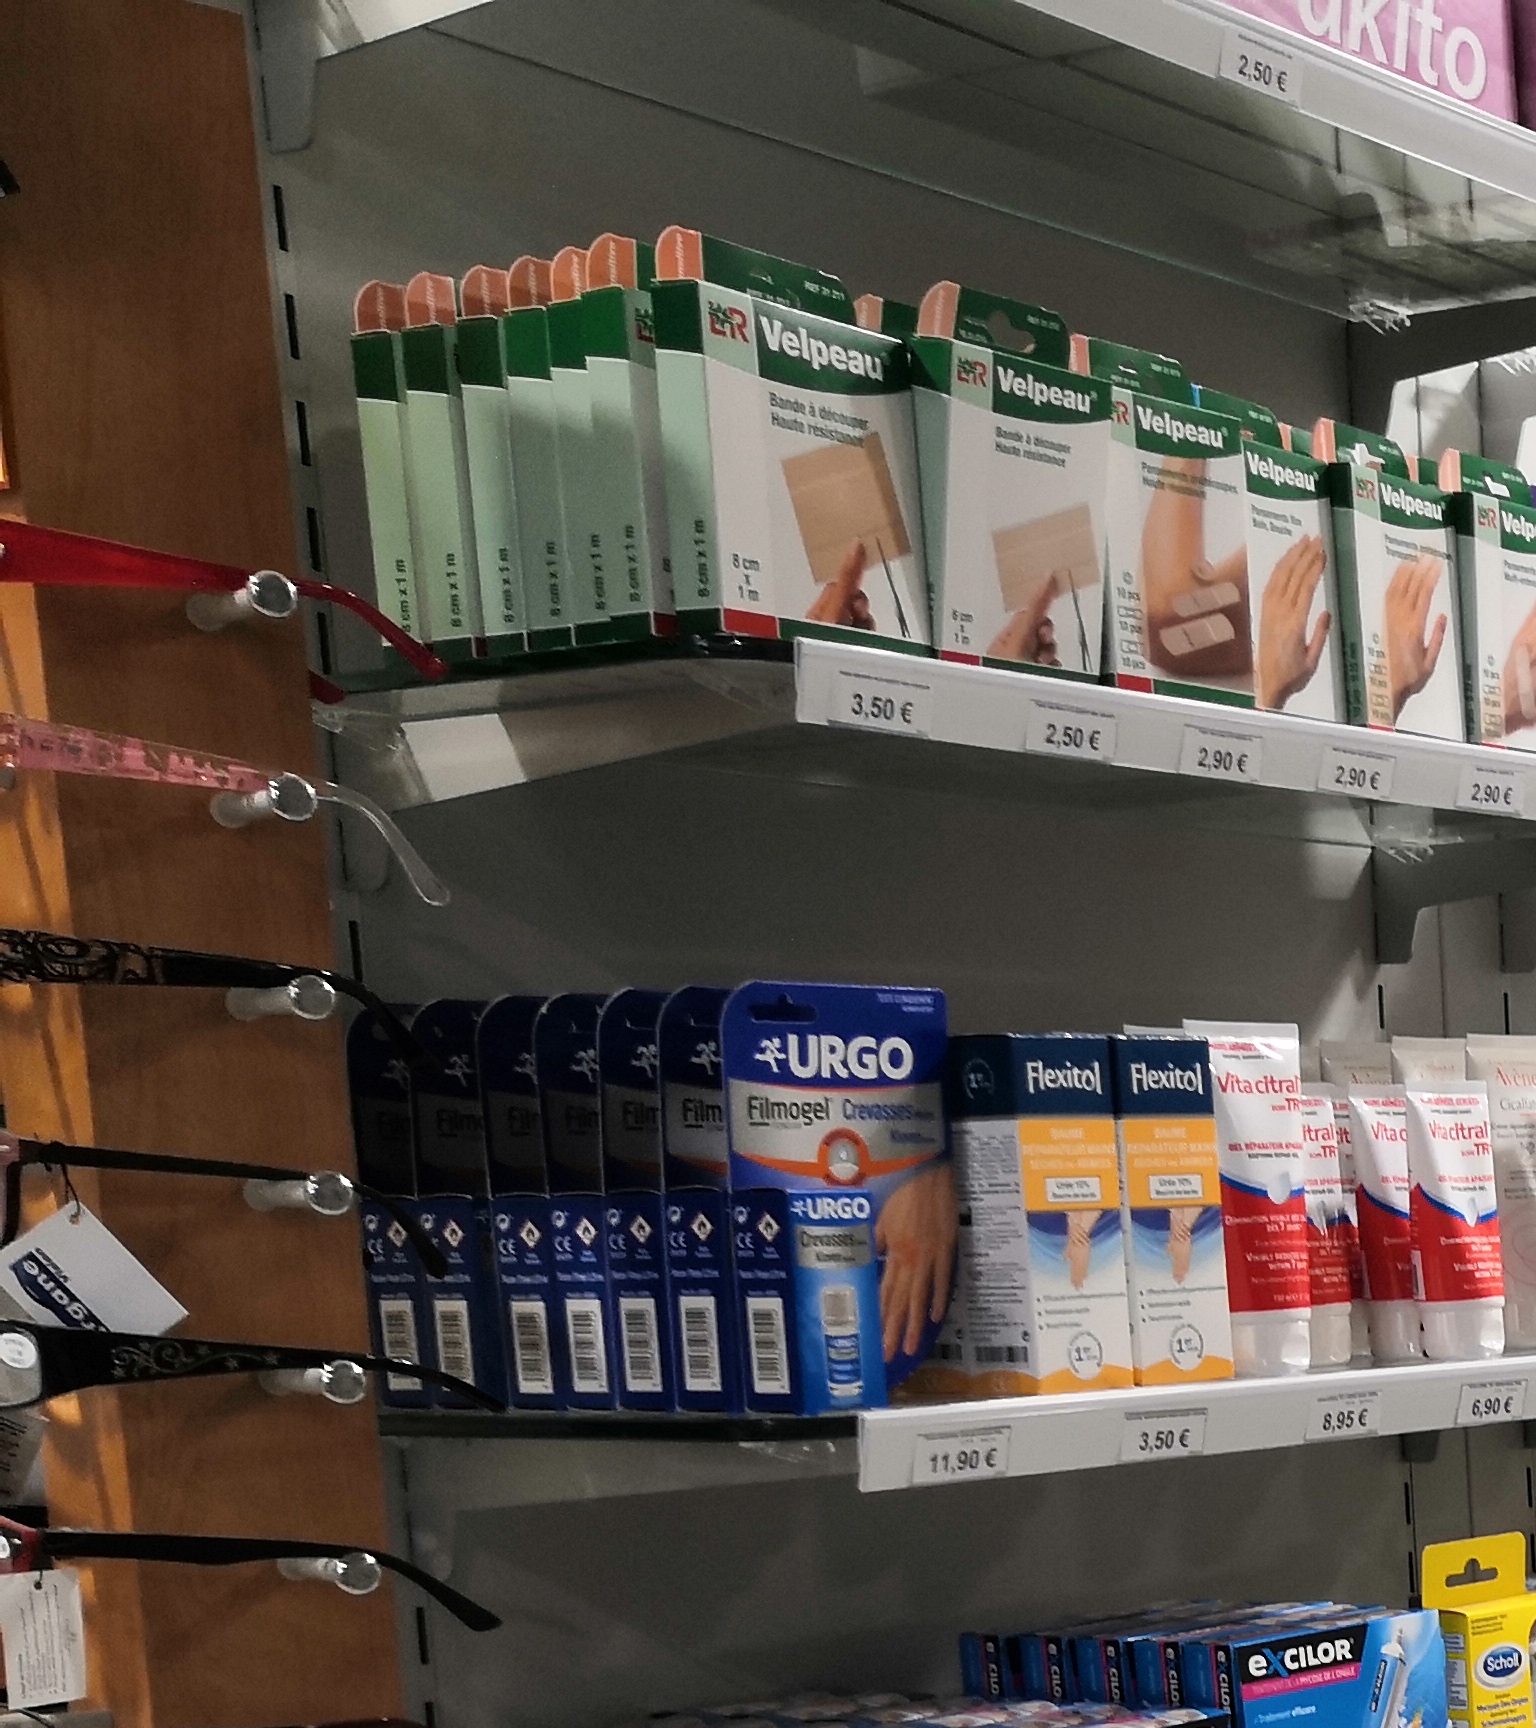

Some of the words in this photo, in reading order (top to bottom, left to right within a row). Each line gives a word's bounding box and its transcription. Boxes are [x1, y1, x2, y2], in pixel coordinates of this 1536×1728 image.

[1237, 53, 1273, 86] 2,50
[1275, 71, 1287, 92] €
[759, 315, 885, 382] Velpeau
[996, 366, 1091, 415] Velpeau
[769, 391, 806, 415] Bande
[819, 406, 869, 431] découper
[771, 411, 806, 434] Haute
[1137, 404, 1225, 449] Velpeau
[1246, 450, 1316, 492] Velpeau
[1380, 482, 1443, 522] Velpeau
[851, 693, 896, 721] 3,50
[901, 701, 914, 724] €
[1045, 723, 1085, 748] 2,50
[1089, 730, 1100, 750] €
[787, 1034, 914, 1080] URGO
[1026, 1061, 1101, 1094] Flexitol
[1131, 1061, 1203, 1096] Flexitol
[747, 1095, 831, 1125] Filmogel
[842, 1100, 913, 1122] Crevasses
[805, 1197, 870, 1220] URGO
[1322, 1410, 1356, 1433] 8,95
[1357, 1408, 1369, 1428] €
[1471, 1397, 1501, 1418] 6,90
[1502, 1395, 1513, 1414] €
[1138, 1429, 1176, 1453] 3,50
[1178, 1428, 1191, 1448] €
[929, 1449, 981, 1474] 11,90
[985, 1447, 997, 1469] €
[1247, 1637, 1353, 1677] eXCILOR
[1485, 1650, 1524, 1675] Scholl
